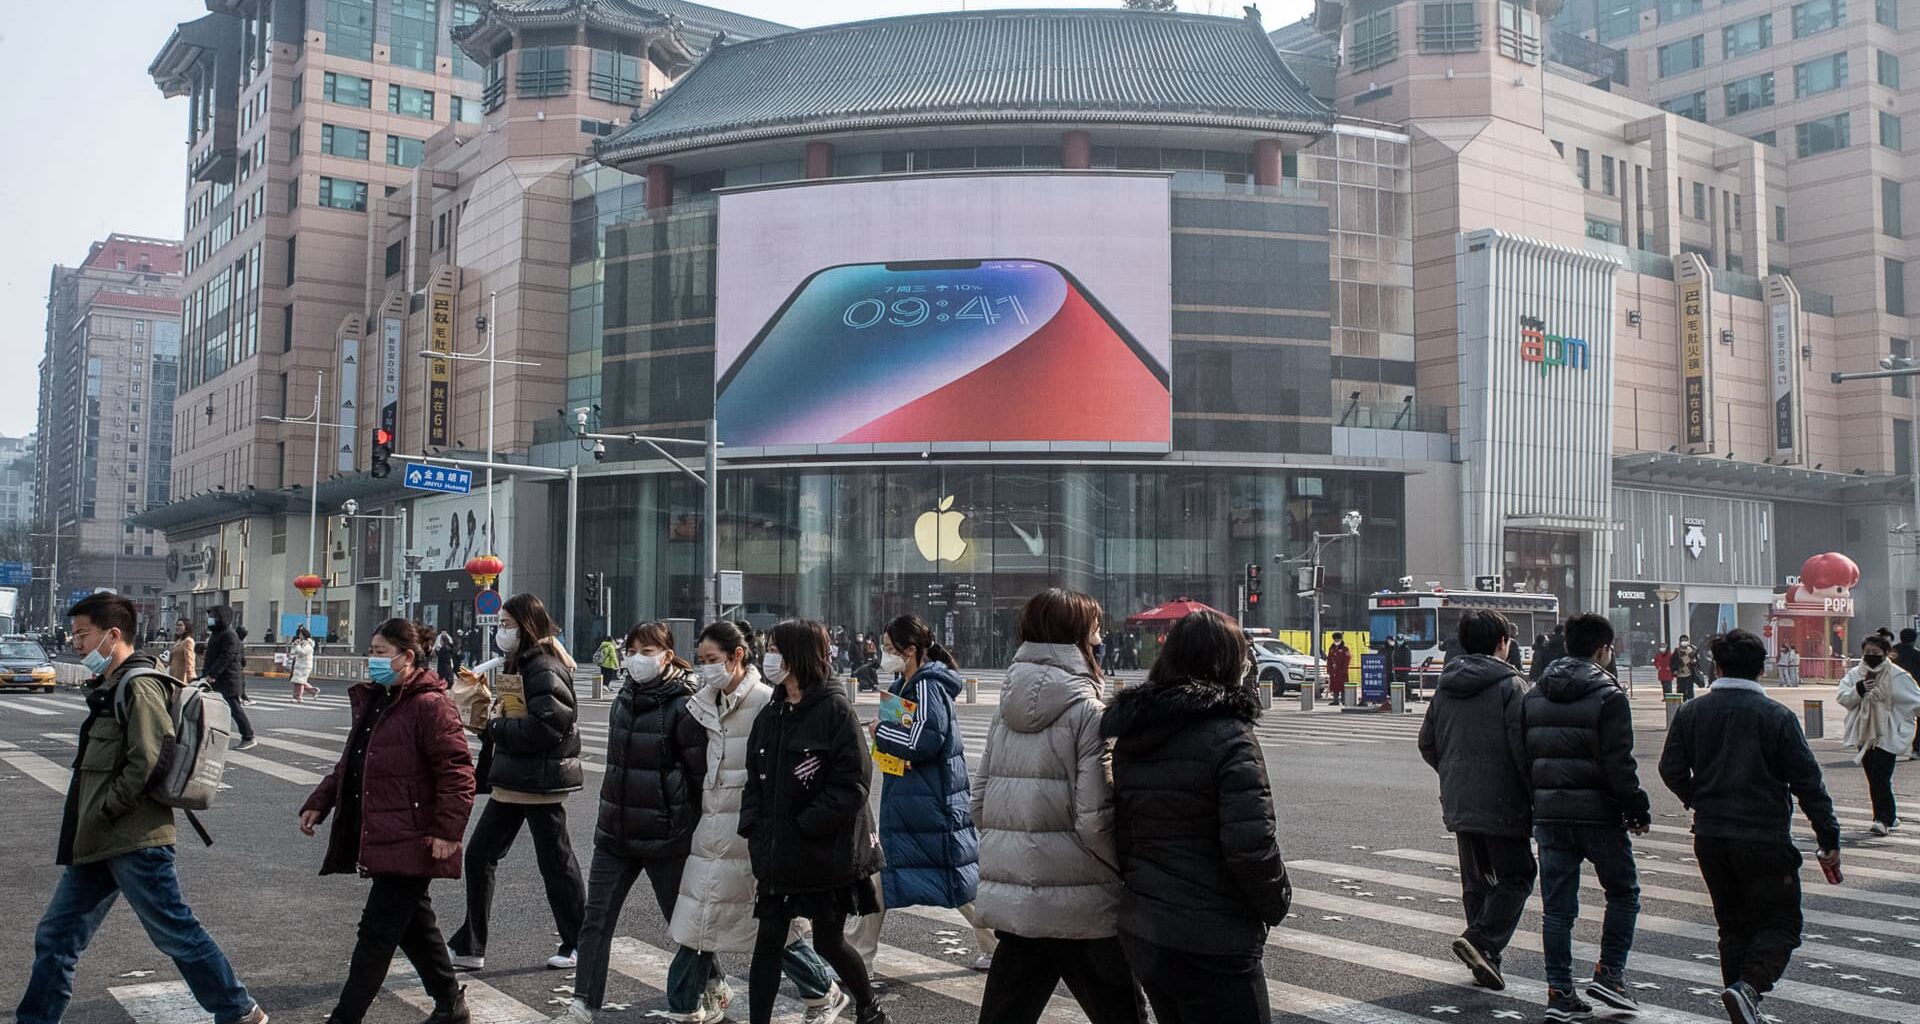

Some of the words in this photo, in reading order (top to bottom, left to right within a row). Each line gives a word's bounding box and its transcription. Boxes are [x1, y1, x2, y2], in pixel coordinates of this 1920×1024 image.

[953, 283, 983, 292] 10%
[843, 295, 1030, 329] 09:41
[1520, 329, 1588, 378] apm
[424, 470, 468, 484] 金鱼胡同
